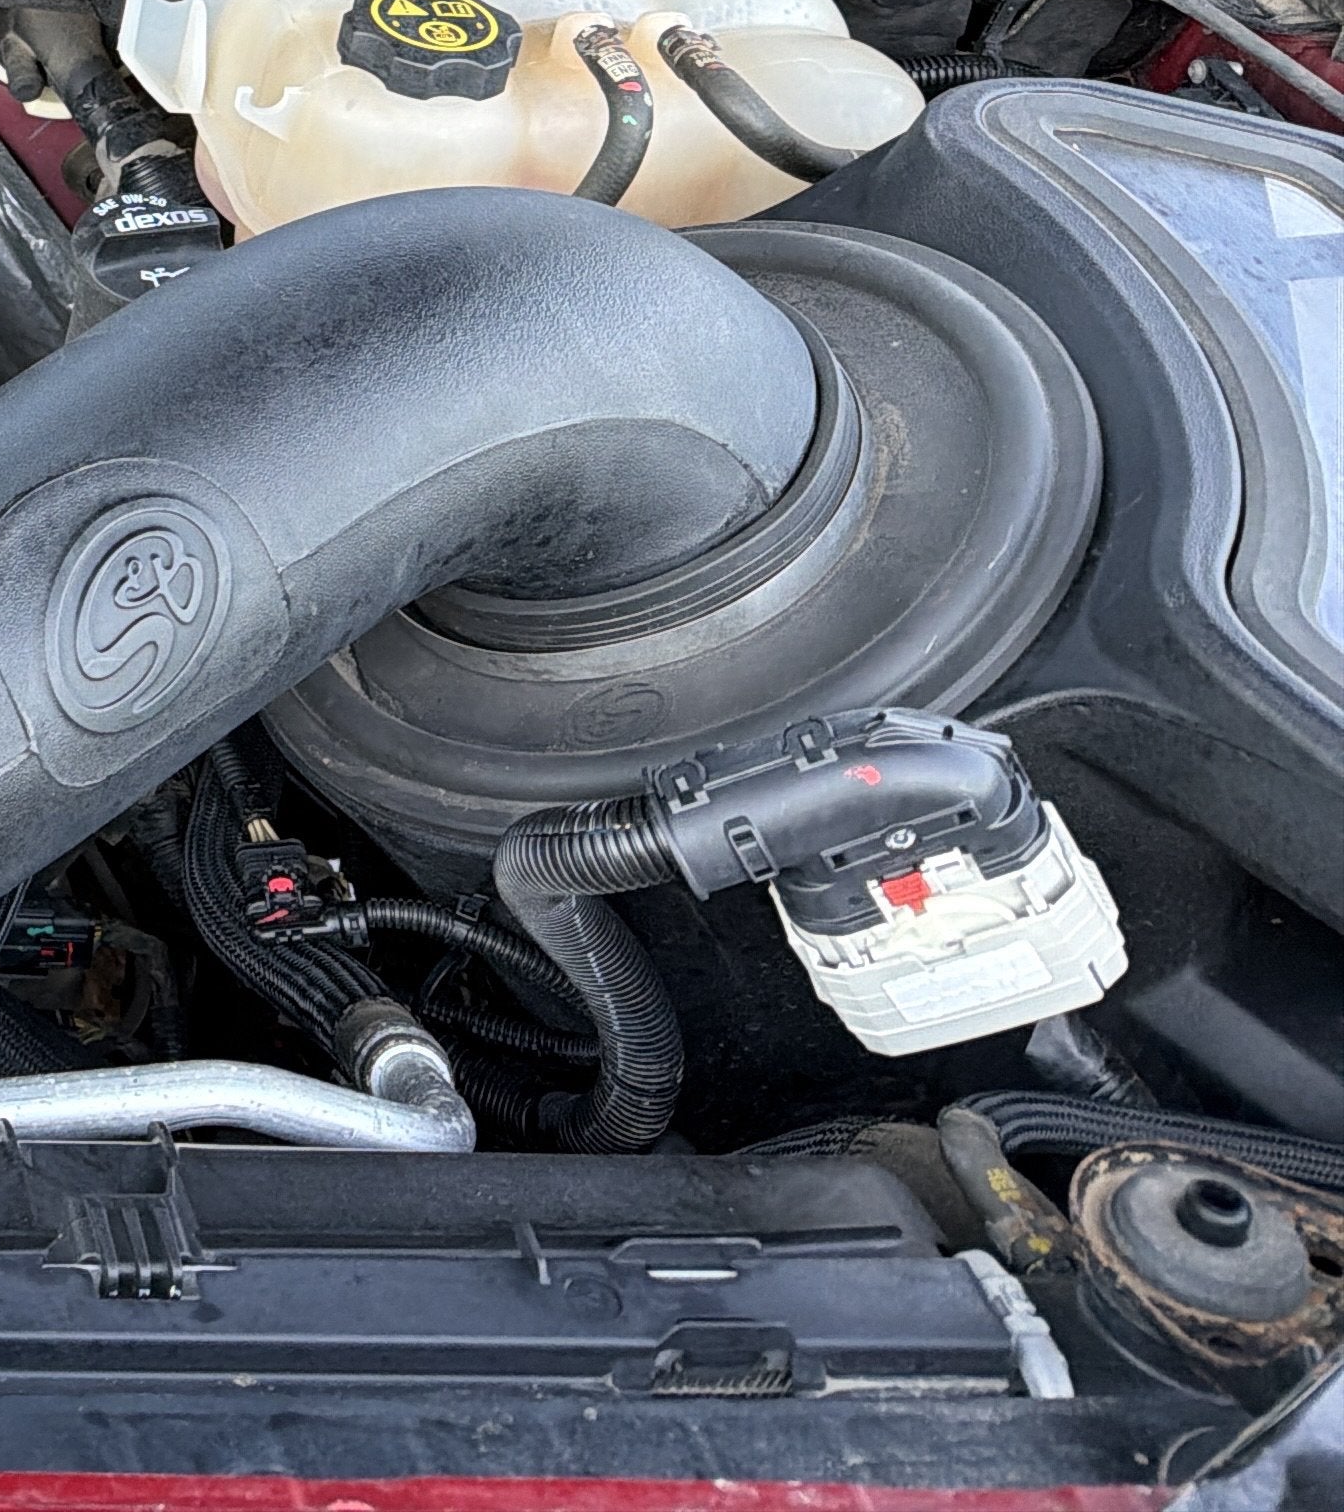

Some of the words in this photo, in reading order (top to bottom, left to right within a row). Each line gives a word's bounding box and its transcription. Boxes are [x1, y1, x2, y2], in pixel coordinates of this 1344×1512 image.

[93, 199, 119, 216] SAE
[121, 194, 167, 207] 0W-20
[115, 209, 208, 232] dexos
